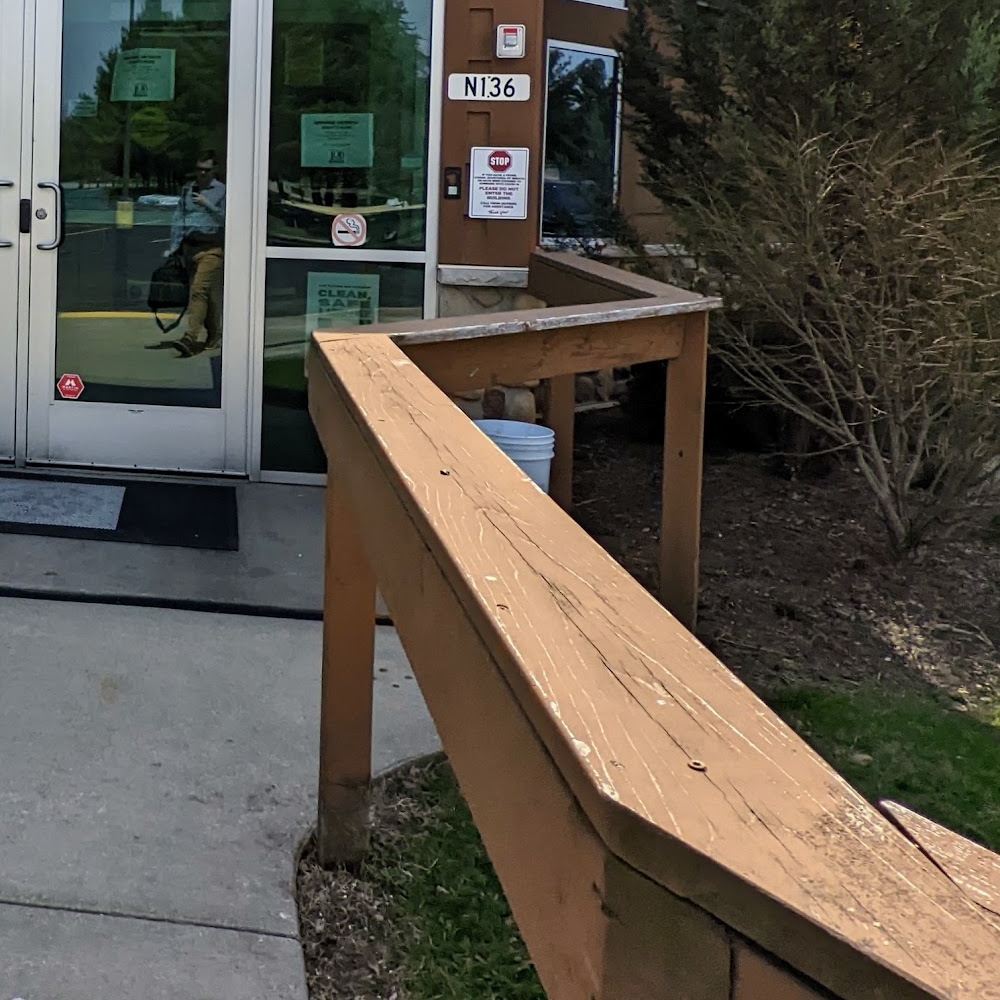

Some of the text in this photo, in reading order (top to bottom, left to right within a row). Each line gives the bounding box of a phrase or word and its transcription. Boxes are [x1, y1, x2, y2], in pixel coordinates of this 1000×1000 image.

[464, 76, 515, 98] N136
[490, 157, 510, 166] STOP
[318, 289, 372, 301] CLEAN,
